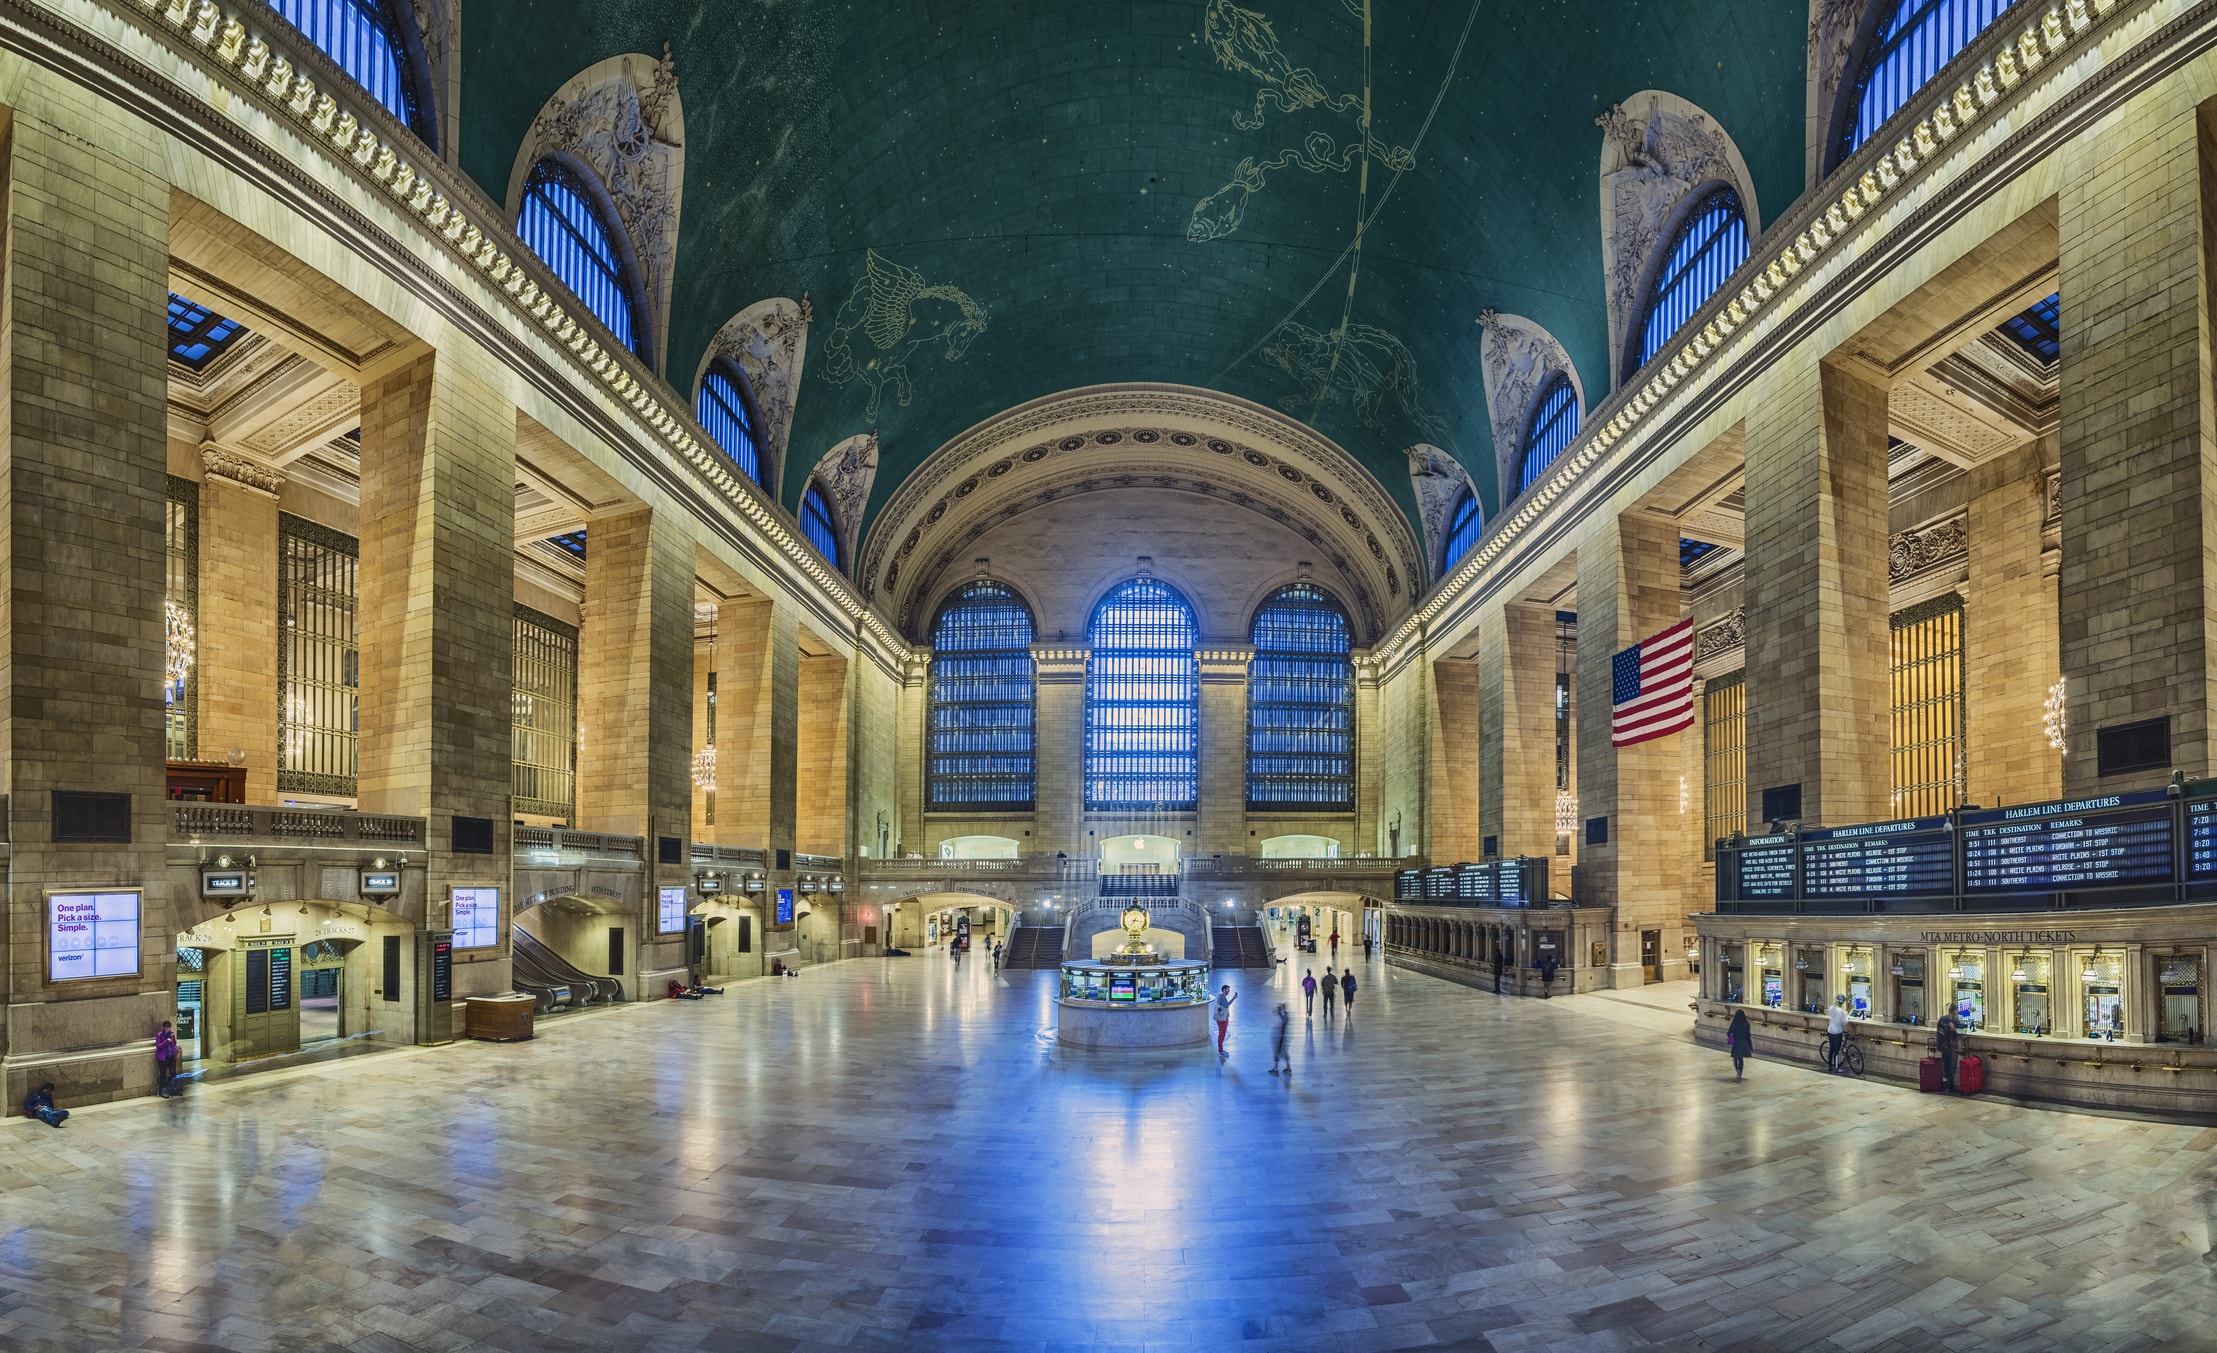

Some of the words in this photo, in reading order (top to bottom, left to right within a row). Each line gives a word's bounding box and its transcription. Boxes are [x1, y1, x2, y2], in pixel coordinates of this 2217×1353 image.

[2005, 807, 2040, 819] HARLEM
[2042, 804, 2062, 814] LINE
[2064, 796, 2119, 811] DEPARTURES
[2190, 803, 2209, 812] TIME
[2194, 816, 2208, 824] 7:20
[1833, 829, 1858, 838] HARLEM
[1859, 827, 1874, 835] LINE
[1875, 822, 1915, 833] DEPARTURES
[2000, 824, 2041, 834] DESTINATION
[2050, 819, 2083, 829] REMARKS
[2001, 836, 2026, 844] SOUTHEAST
[2052, 831, 2083, 840] CONNECTION
[2095, 827, 2118, 835] WASSAIC
[2194, 828, 2209, 836] 7:48
[1750, 836, 1784, 845] INFORMATION
[2194, 839, 2209, 847] 8:20
[2195, 850, 2210, 859] 8:48
[2001, 857, 2027, 865] SOUTHEAST
[2195, 862, 2210, 871] 9:20
[2053, 873, 2084, 882] CONNECTION
[549, 885, 575, 896] BUILDING
[956, 887, 986, 895] LEXINGTON
[57, 904, 74, 912] One
[76, 904, 95, 913] plan.
[83, 913, 102, 921] size.
[57, 924, 88, 932] Simple.
[178, 934, 201, 942] RACK
[1920, 932, 1941, 941] MTA
[1944, 931, 2024, 942] METRO-NORTH
[2027, 930, 2076, 941] TICKETS
